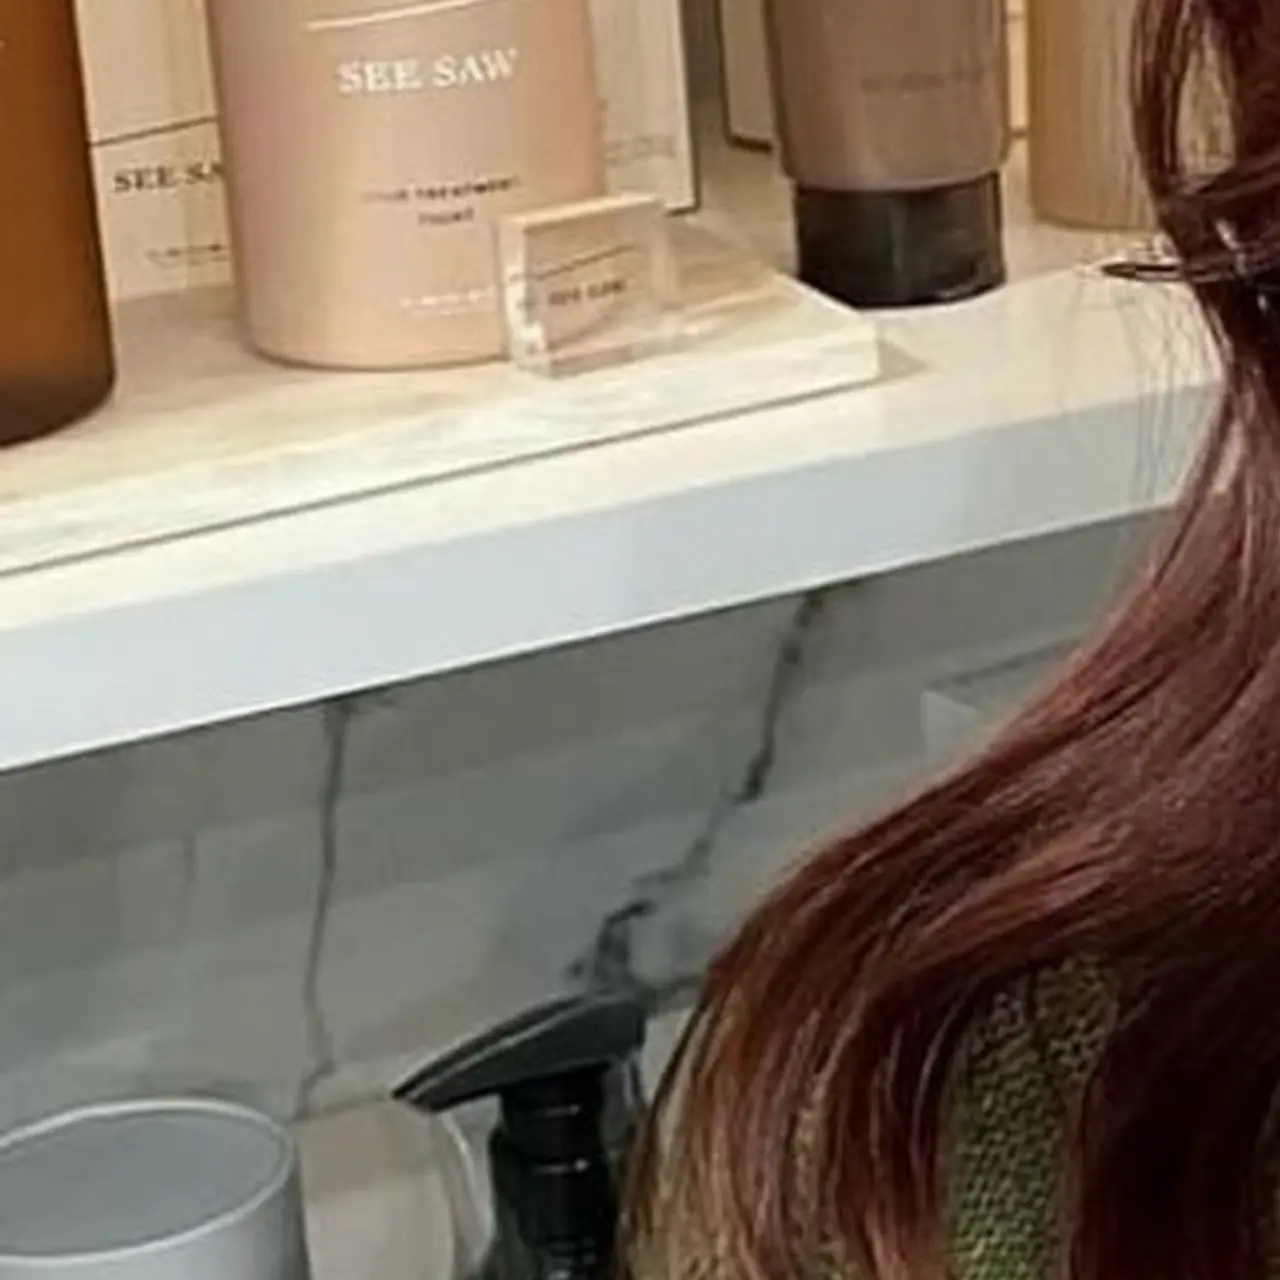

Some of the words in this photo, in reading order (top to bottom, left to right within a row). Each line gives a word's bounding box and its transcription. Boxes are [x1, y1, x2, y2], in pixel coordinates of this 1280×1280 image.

[336, 57, 424, 94] SEE
[432, 47, 519, 87] SAW
[112, 165, 180, 194] SEE
